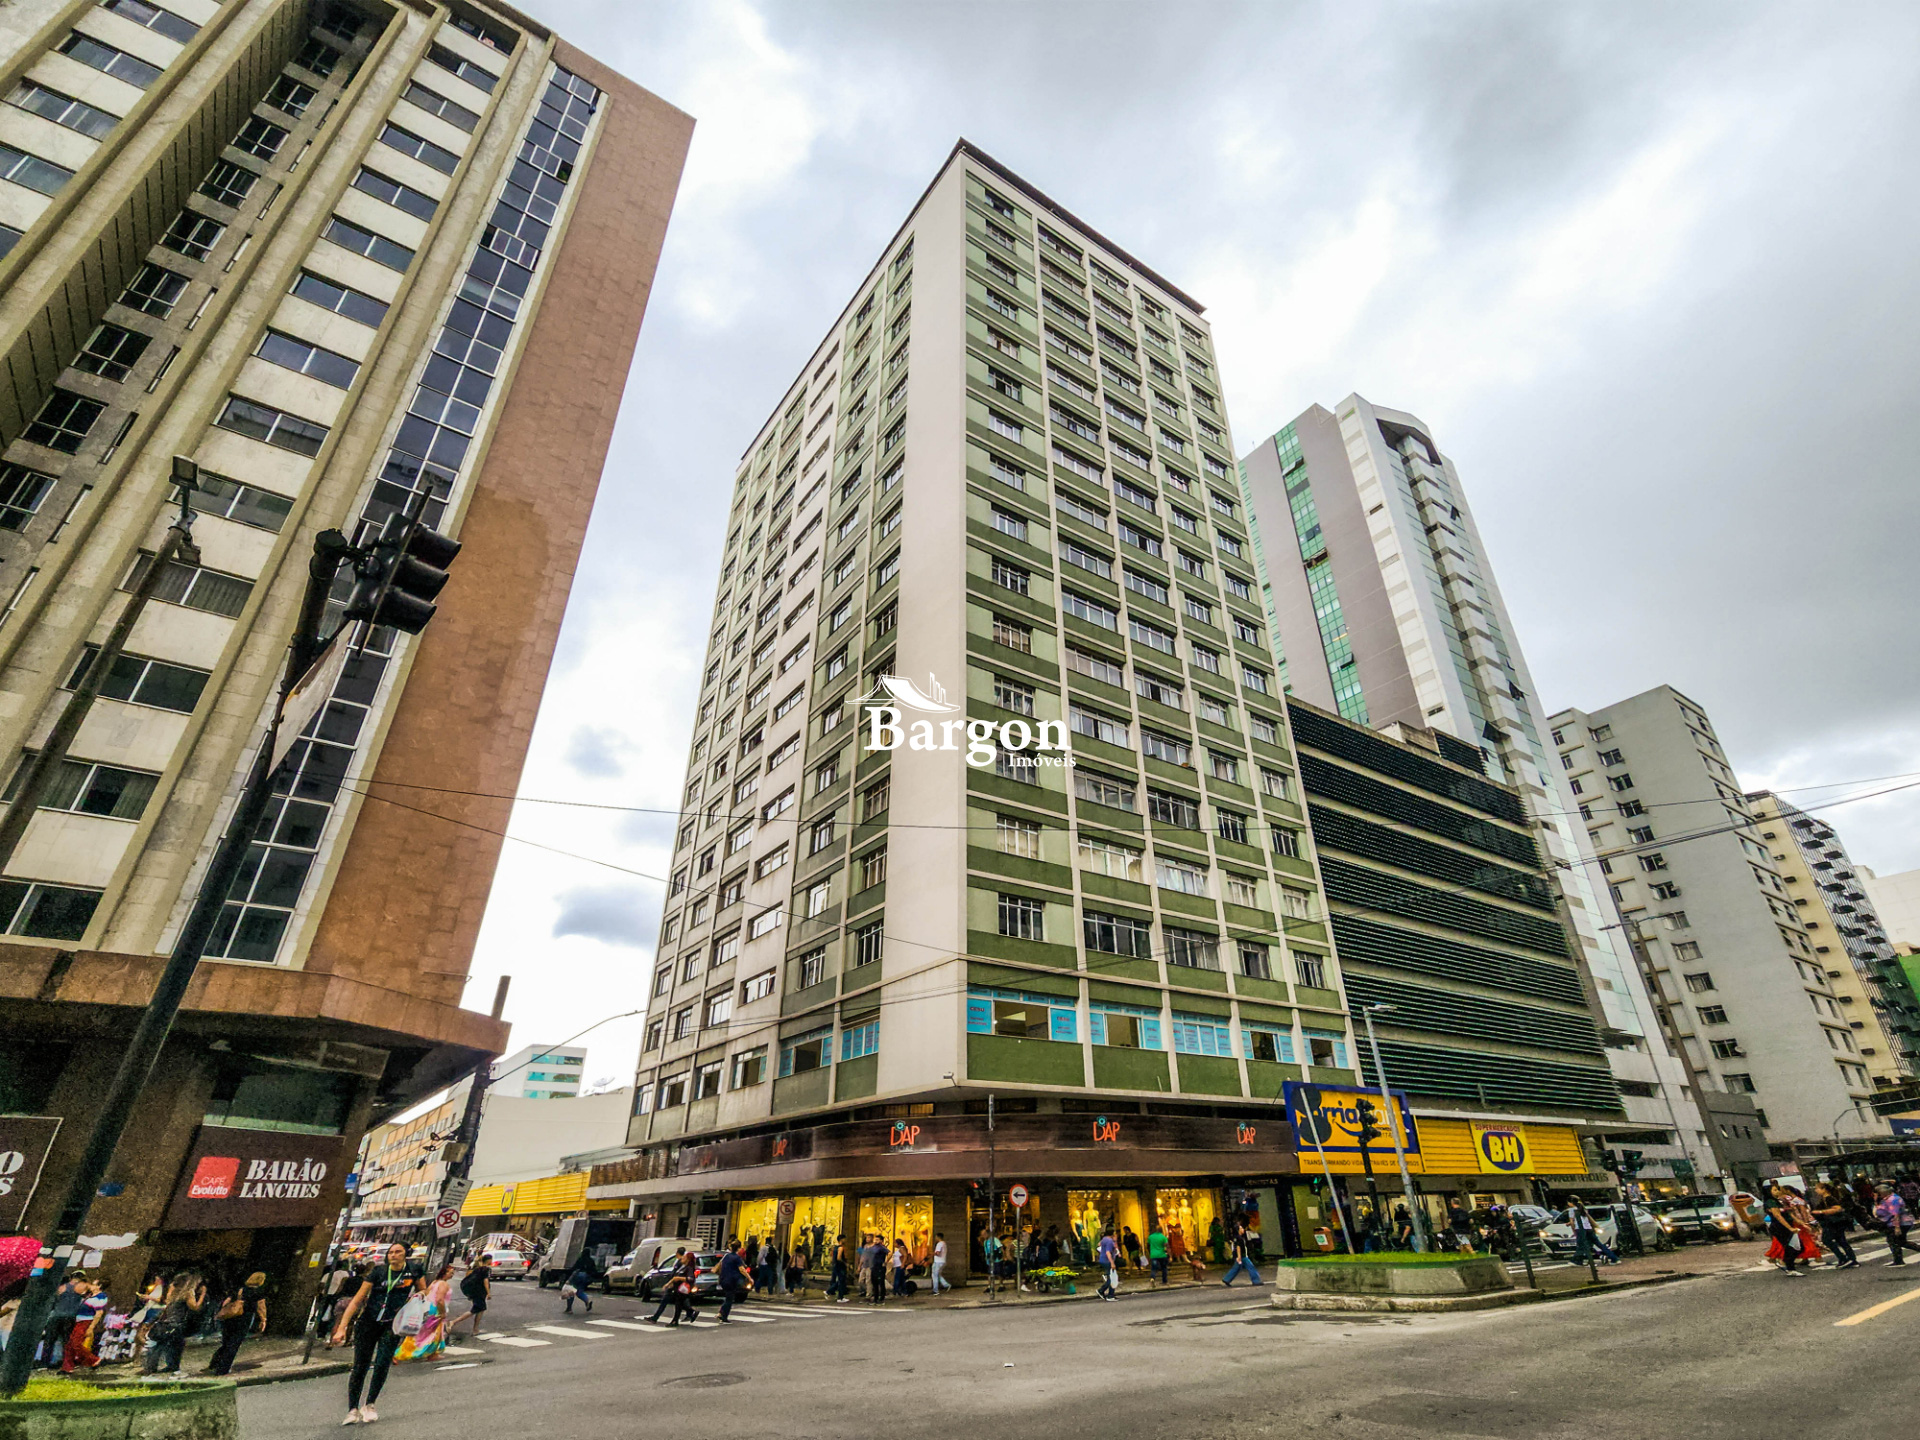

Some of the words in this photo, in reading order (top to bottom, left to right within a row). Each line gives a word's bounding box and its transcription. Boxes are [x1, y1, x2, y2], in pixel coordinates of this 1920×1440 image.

[890, 1125, 920, 1146] DAP
[1488, 1135, 1520, 1163] BH
[245, 1158, 327, 1182] BARÃO
[200, 1176, 227, 1186] CAFÉ
[238, 1182, 321, 1198] LANCHES
